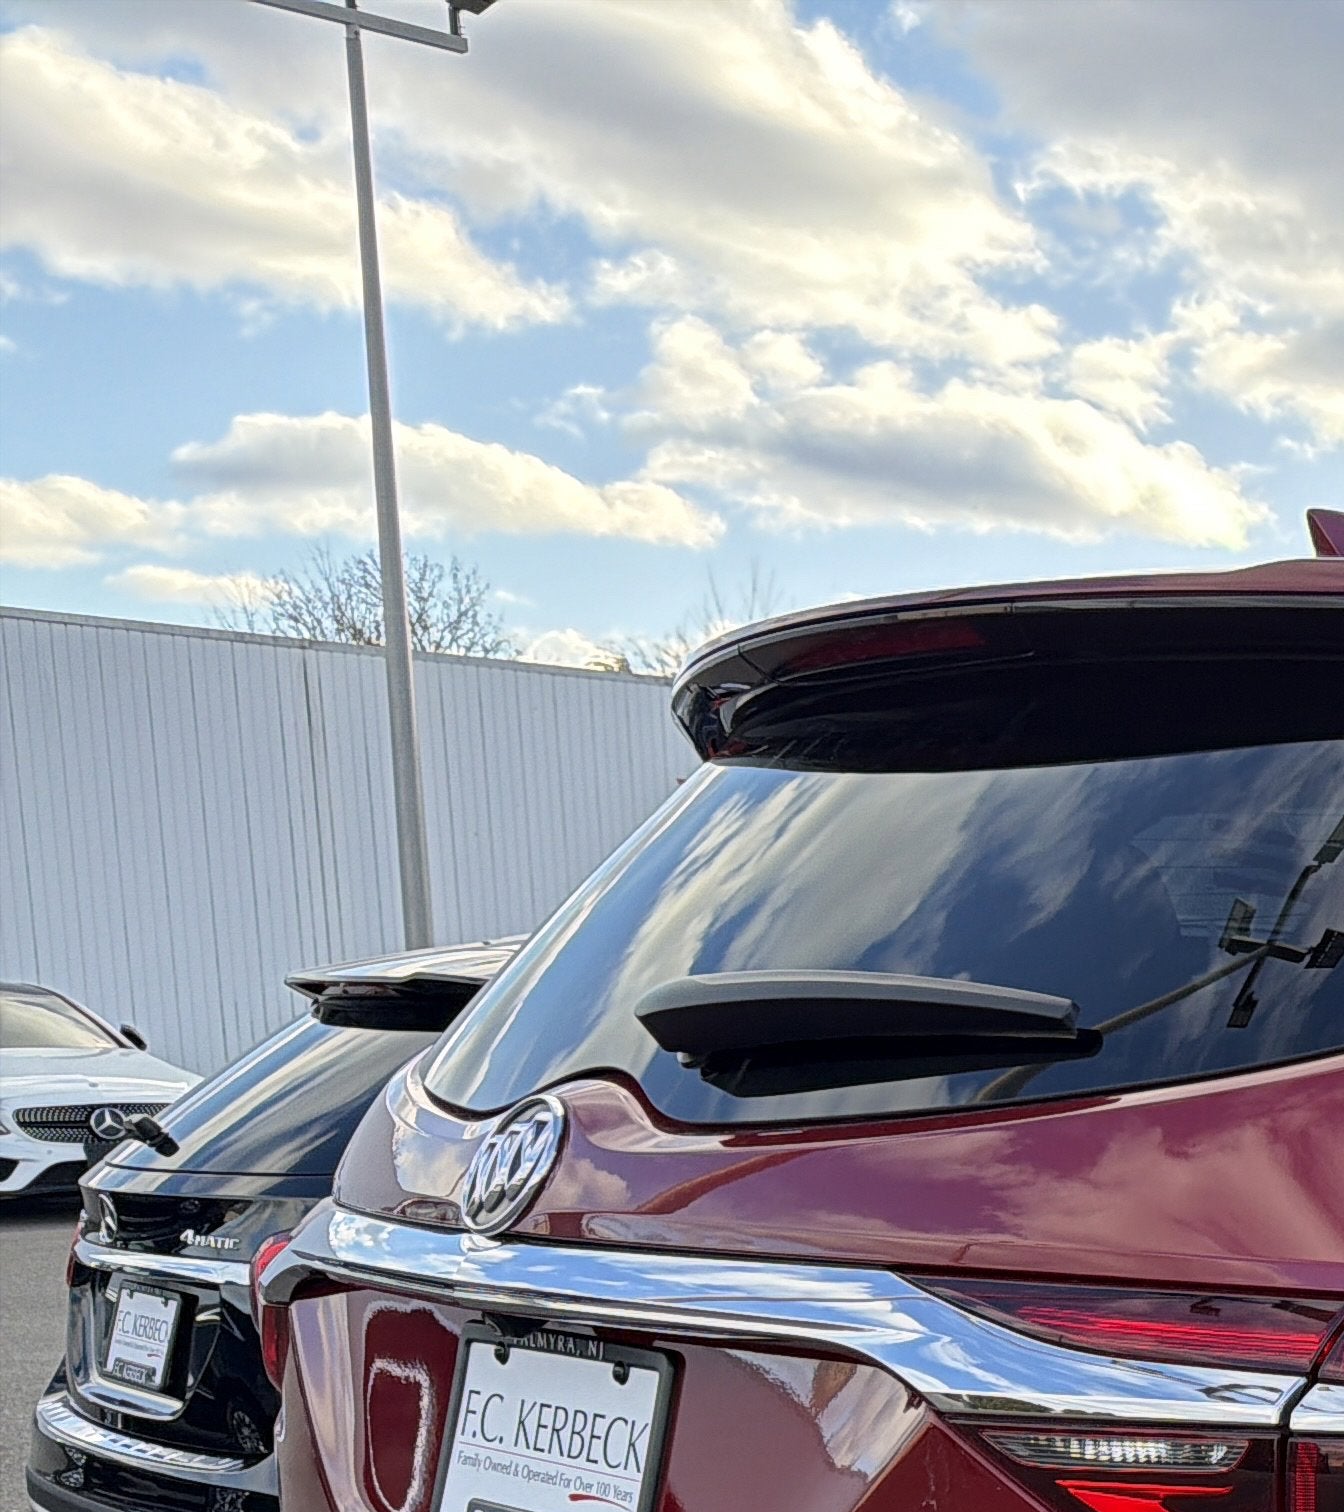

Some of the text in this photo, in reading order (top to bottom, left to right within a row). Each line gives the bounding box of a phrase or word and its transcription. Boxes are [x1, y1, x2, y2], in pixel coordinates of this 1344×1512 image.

[179, 1228, 240, 1250] 4MATIC
[460, 1389, 649, 1473] F.C. KERBECK
[457, 1450, 482, 1472] Family
[483, 1456, 513, 1476] Owned
[521, 1464, 559, 1486] Operated
[559, 1472, 572, 1489] For
[574, 1476, 594, 1493] Over
[596, 1481, 610, 1498] 100
[613, 1484, 634, 1503] Years
